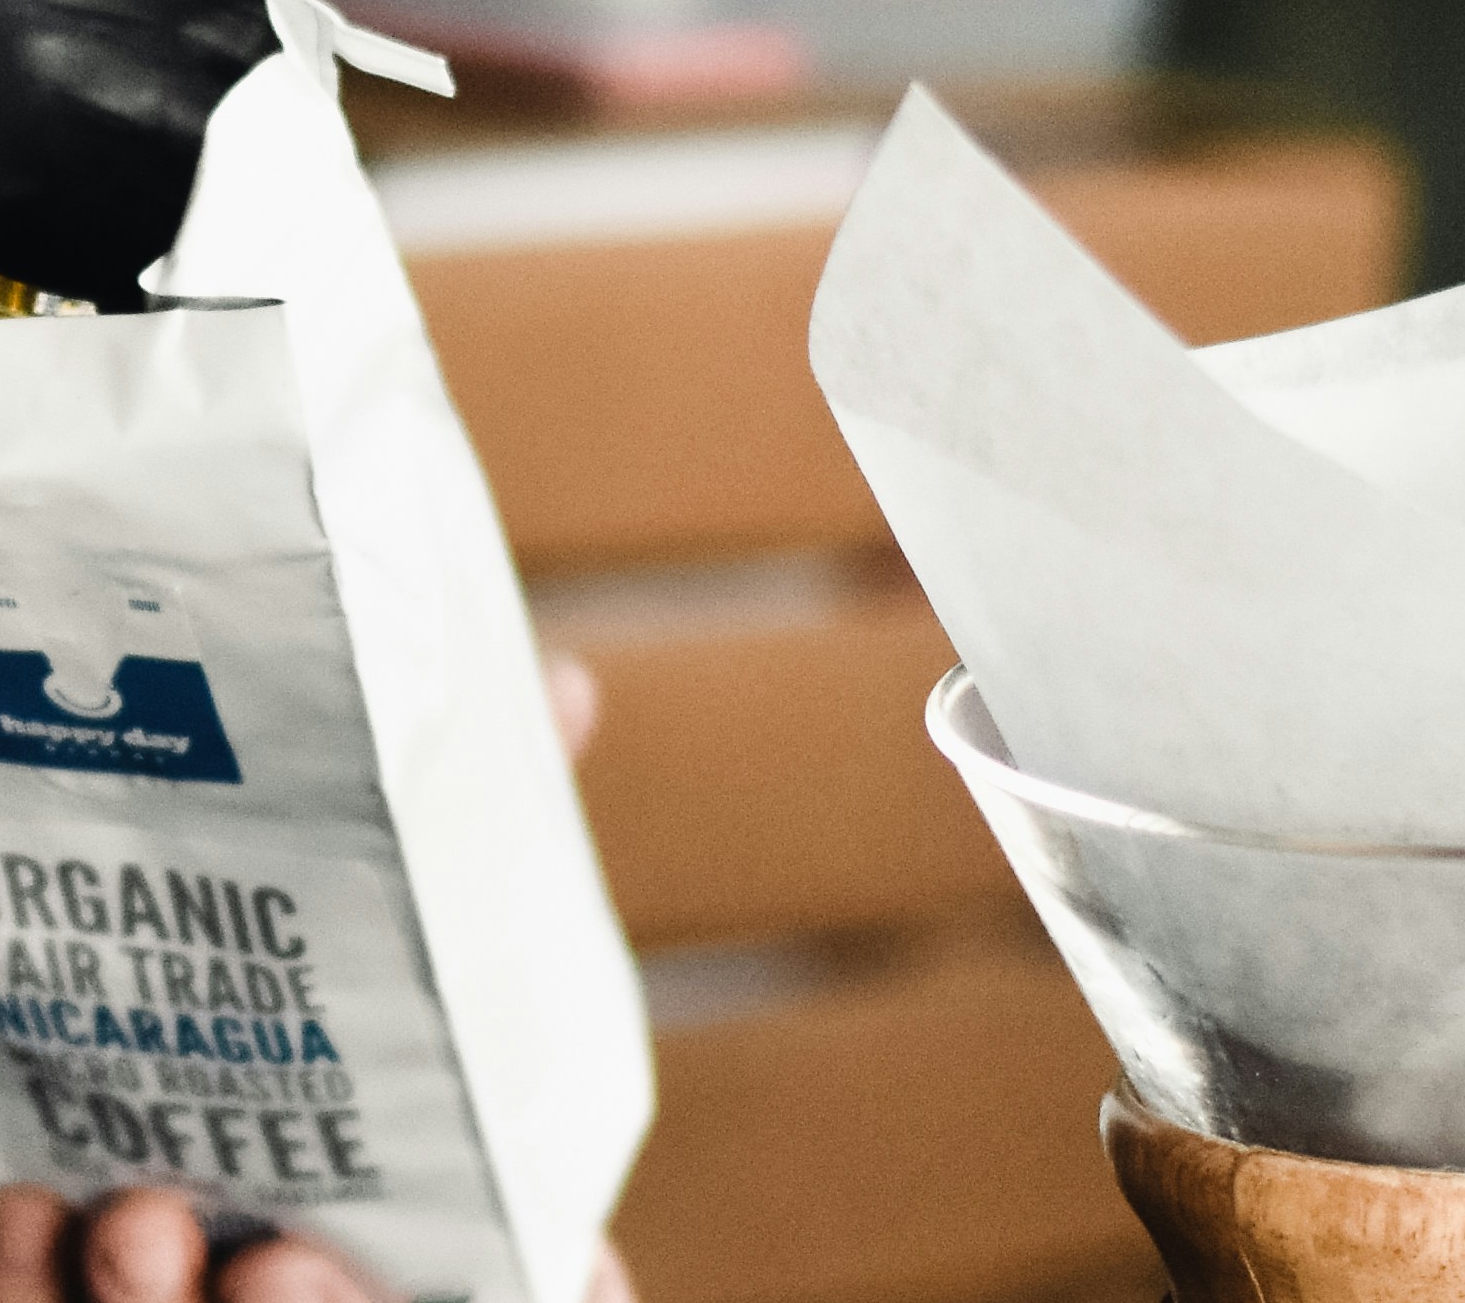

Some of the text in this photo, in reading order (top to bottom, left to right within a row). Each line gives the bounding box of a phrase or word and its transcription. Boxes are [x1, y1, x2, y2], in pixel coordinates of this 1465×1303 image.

[123, 727, 190, 755] day
[122, 944, 325, 1017] TRADE
[153, 1053, 356, 1104] ROASTED
[26, 1073, 380, 1182] COFFEE
